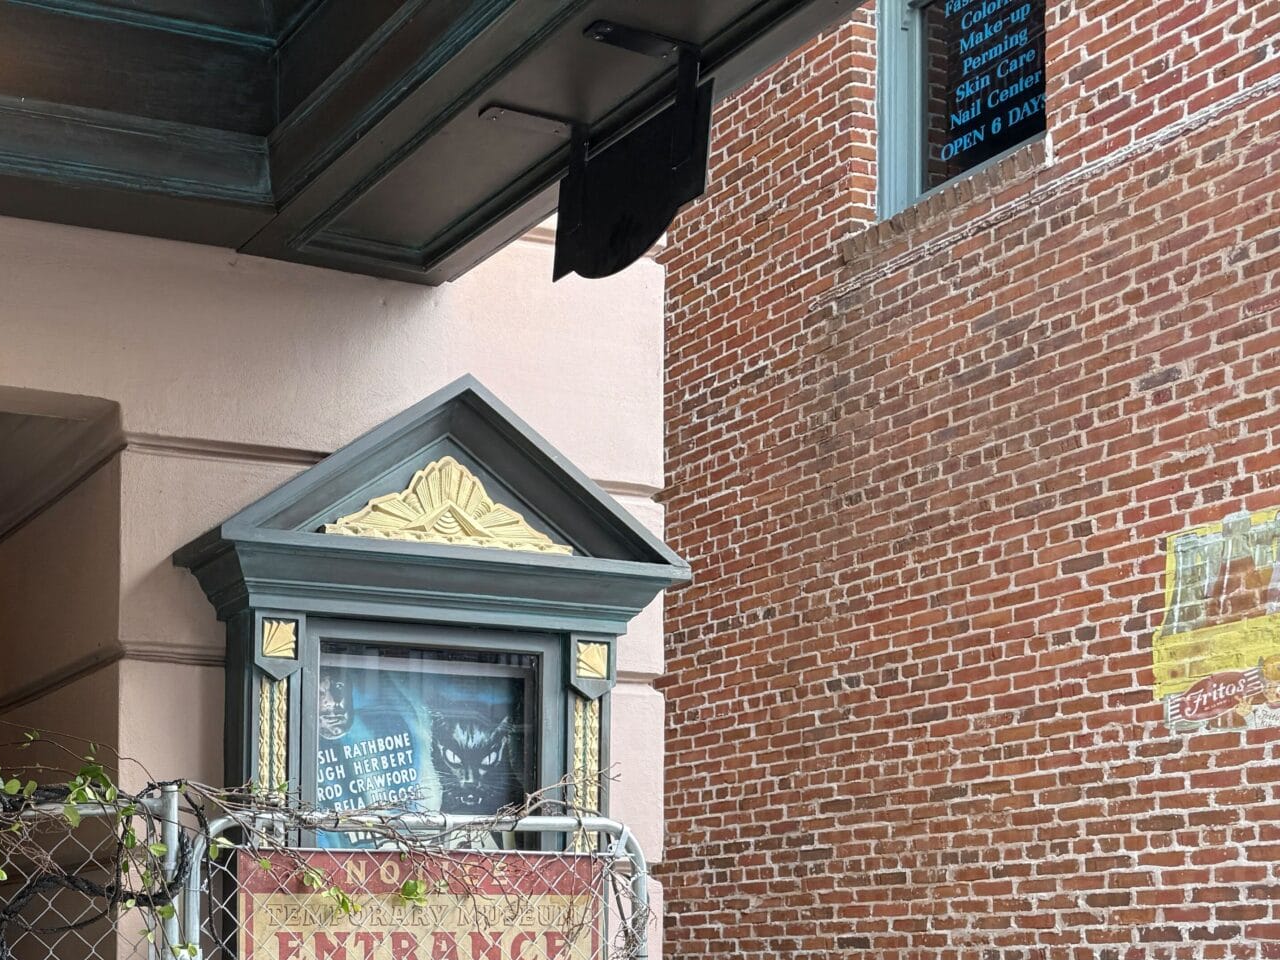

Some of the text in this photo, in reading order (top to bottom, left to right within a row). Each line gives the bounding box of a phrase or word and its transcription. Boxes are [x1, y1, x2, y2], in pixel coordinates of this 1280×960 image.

[959, 3, 1031, 55] Make-up
[961, 27, 1028, 77] Perming
[955, 48, 1036, 104] Skin Care
[949, 69, 1042, 131] Nail Center
[940, 125, 986, 162] OPEN
[990, 117, 1002, 136] 6
[1184, 678, 1246, 716] Fritos
[343, 731, 412, 760] RATHBONE
[353, 749, 415, 774] HERBERT
[348, 766, 418, 793] CRAWFORD
[266, 901, 586, 928] TEMPORARY MUSEUM
